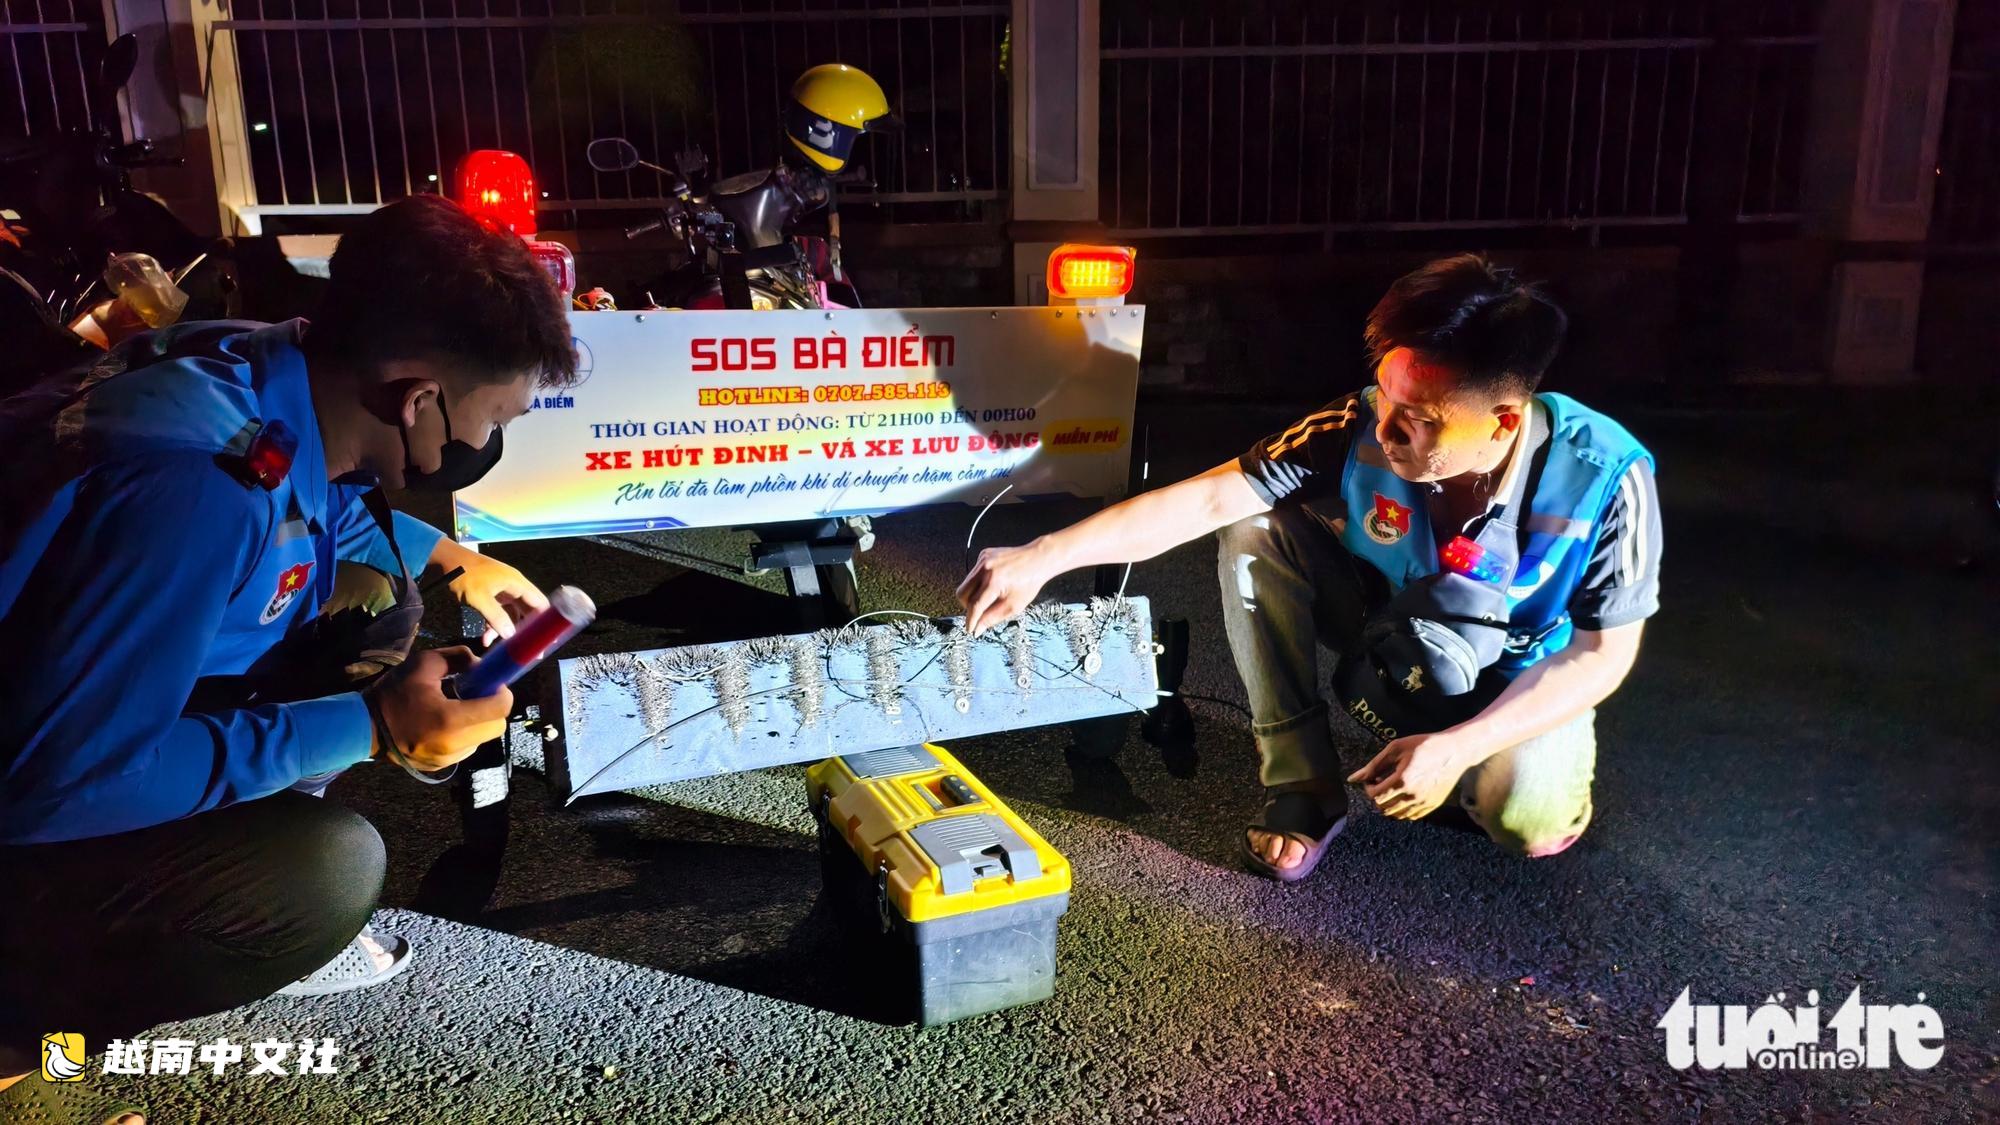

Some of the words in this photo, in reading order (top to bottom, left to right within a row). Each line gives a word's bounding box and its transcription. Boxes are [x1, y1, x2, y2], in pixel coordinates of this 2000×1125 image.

[691, 338, 776, 371] SOS
[794, 330, 846, 369] BÀ
[862, 323, 955, 368] ĐIỂM
[699, 386, 809, 406] HOTLINE:
[814, 381, 951, 401] 0707.585.113
[590, 420, 646, 438] THỜI
[653, 421, 706, 436] GIAN
[714, 418, 771, 436] HOẠT
[777, 413, 839, 433] ĐỘNG:
[846, 411, 874, 428] TỪ
[877, 411, 934, 427] 21H00
[940, 405, 977, 424] ĐẾN
[983, 407, 1036, 422] 00H00
[1093, 426, 1120, 443] PHÍ
[585, 451, 632, 470] XE
[643, 444, 703, 468] HÚT
[713, 444, 788, 465] ĐINH
[821, 436, 856, 459] VÁ
[865, 439, 903, 457] XE
[912, 436, 960, 454] LƯU
[968, 430, 1040, 455] ĐỘNG
[615, 481, 655, 506] Xin
[659, 480, 684, 498] lỗi
[686, 478, 709, 497] đã
[713, 478, 745, 496] làm
[747, 473, 797, 498] phiền
[800, 472, 830, 490] khi
[832, 471, 852, 488] di
[853, 466, 909, 493] chuyển
[957, 464, 987, 480] cảm
[1355, 697, 1397, 738] POLO
